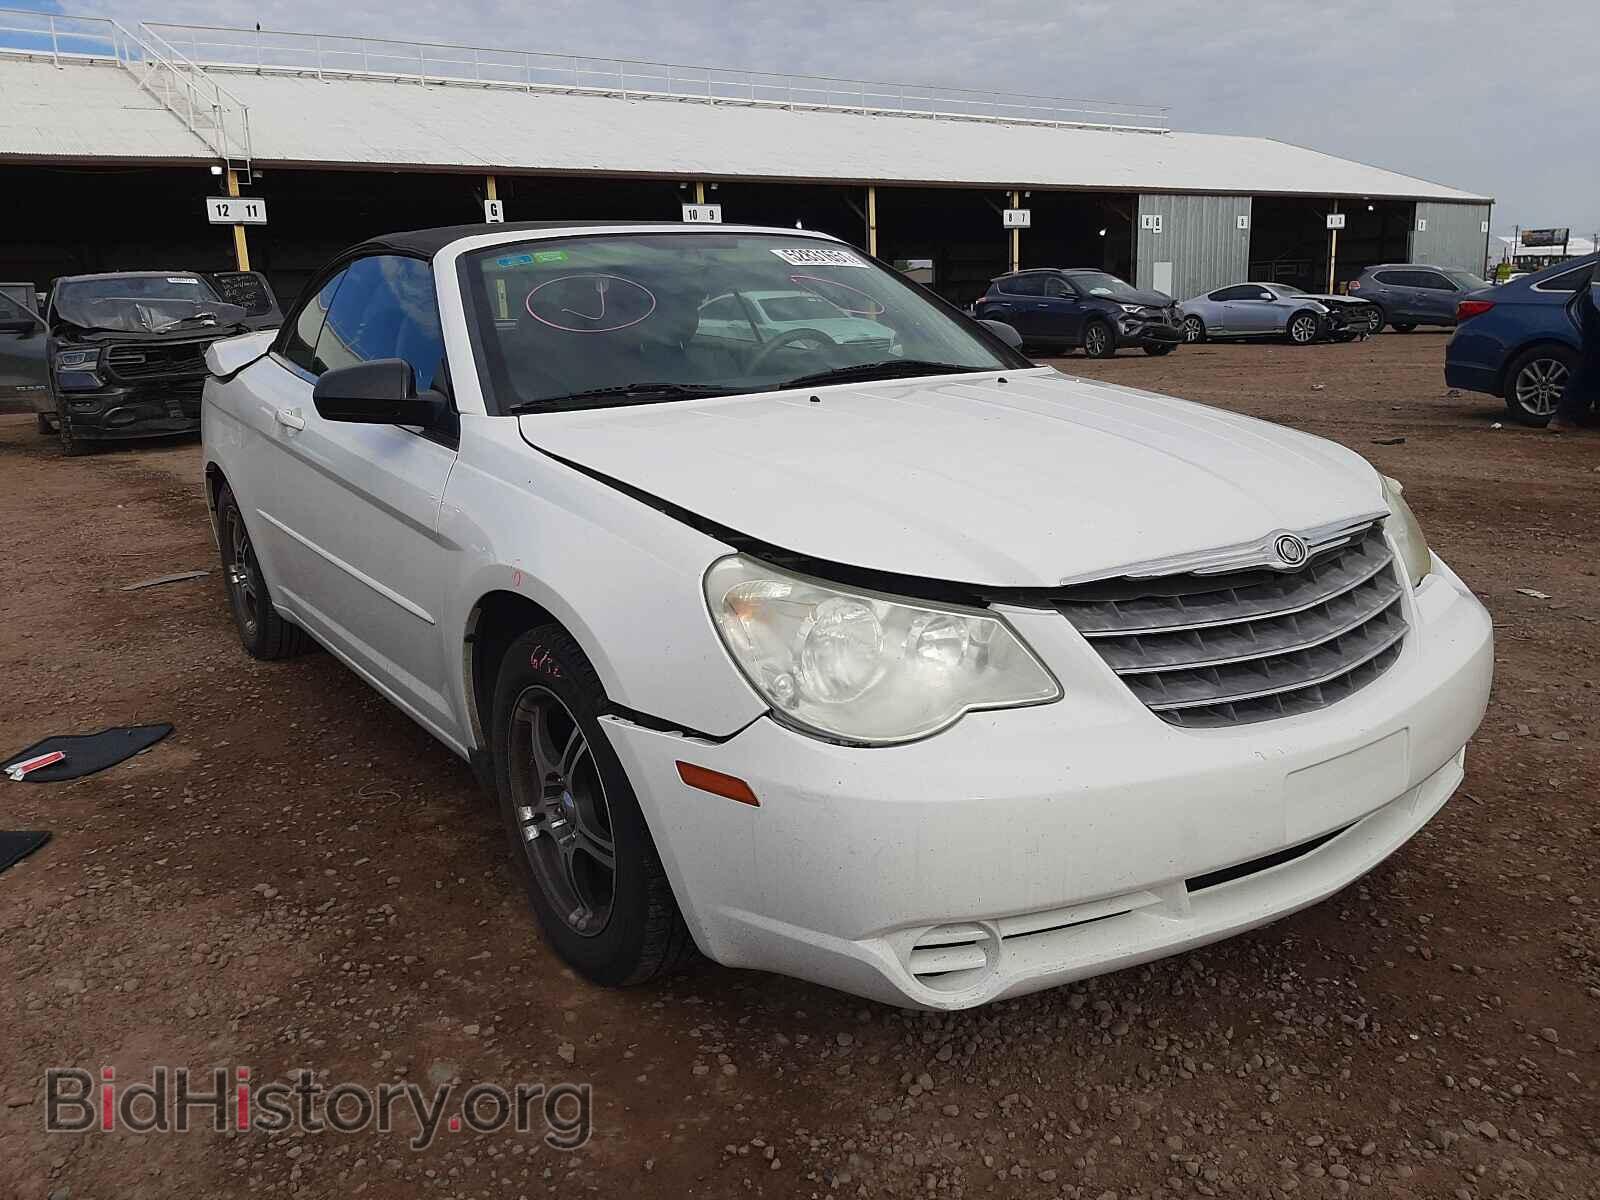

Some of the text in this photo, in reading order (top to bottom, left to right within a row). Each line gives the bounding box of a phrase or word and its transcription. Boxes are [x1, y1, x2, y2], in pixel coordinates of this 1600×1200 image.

[215, 203, 258, 217] 12 11
[490, 202, 498, 216] G
[688, 209, 715, 221] 10 9
